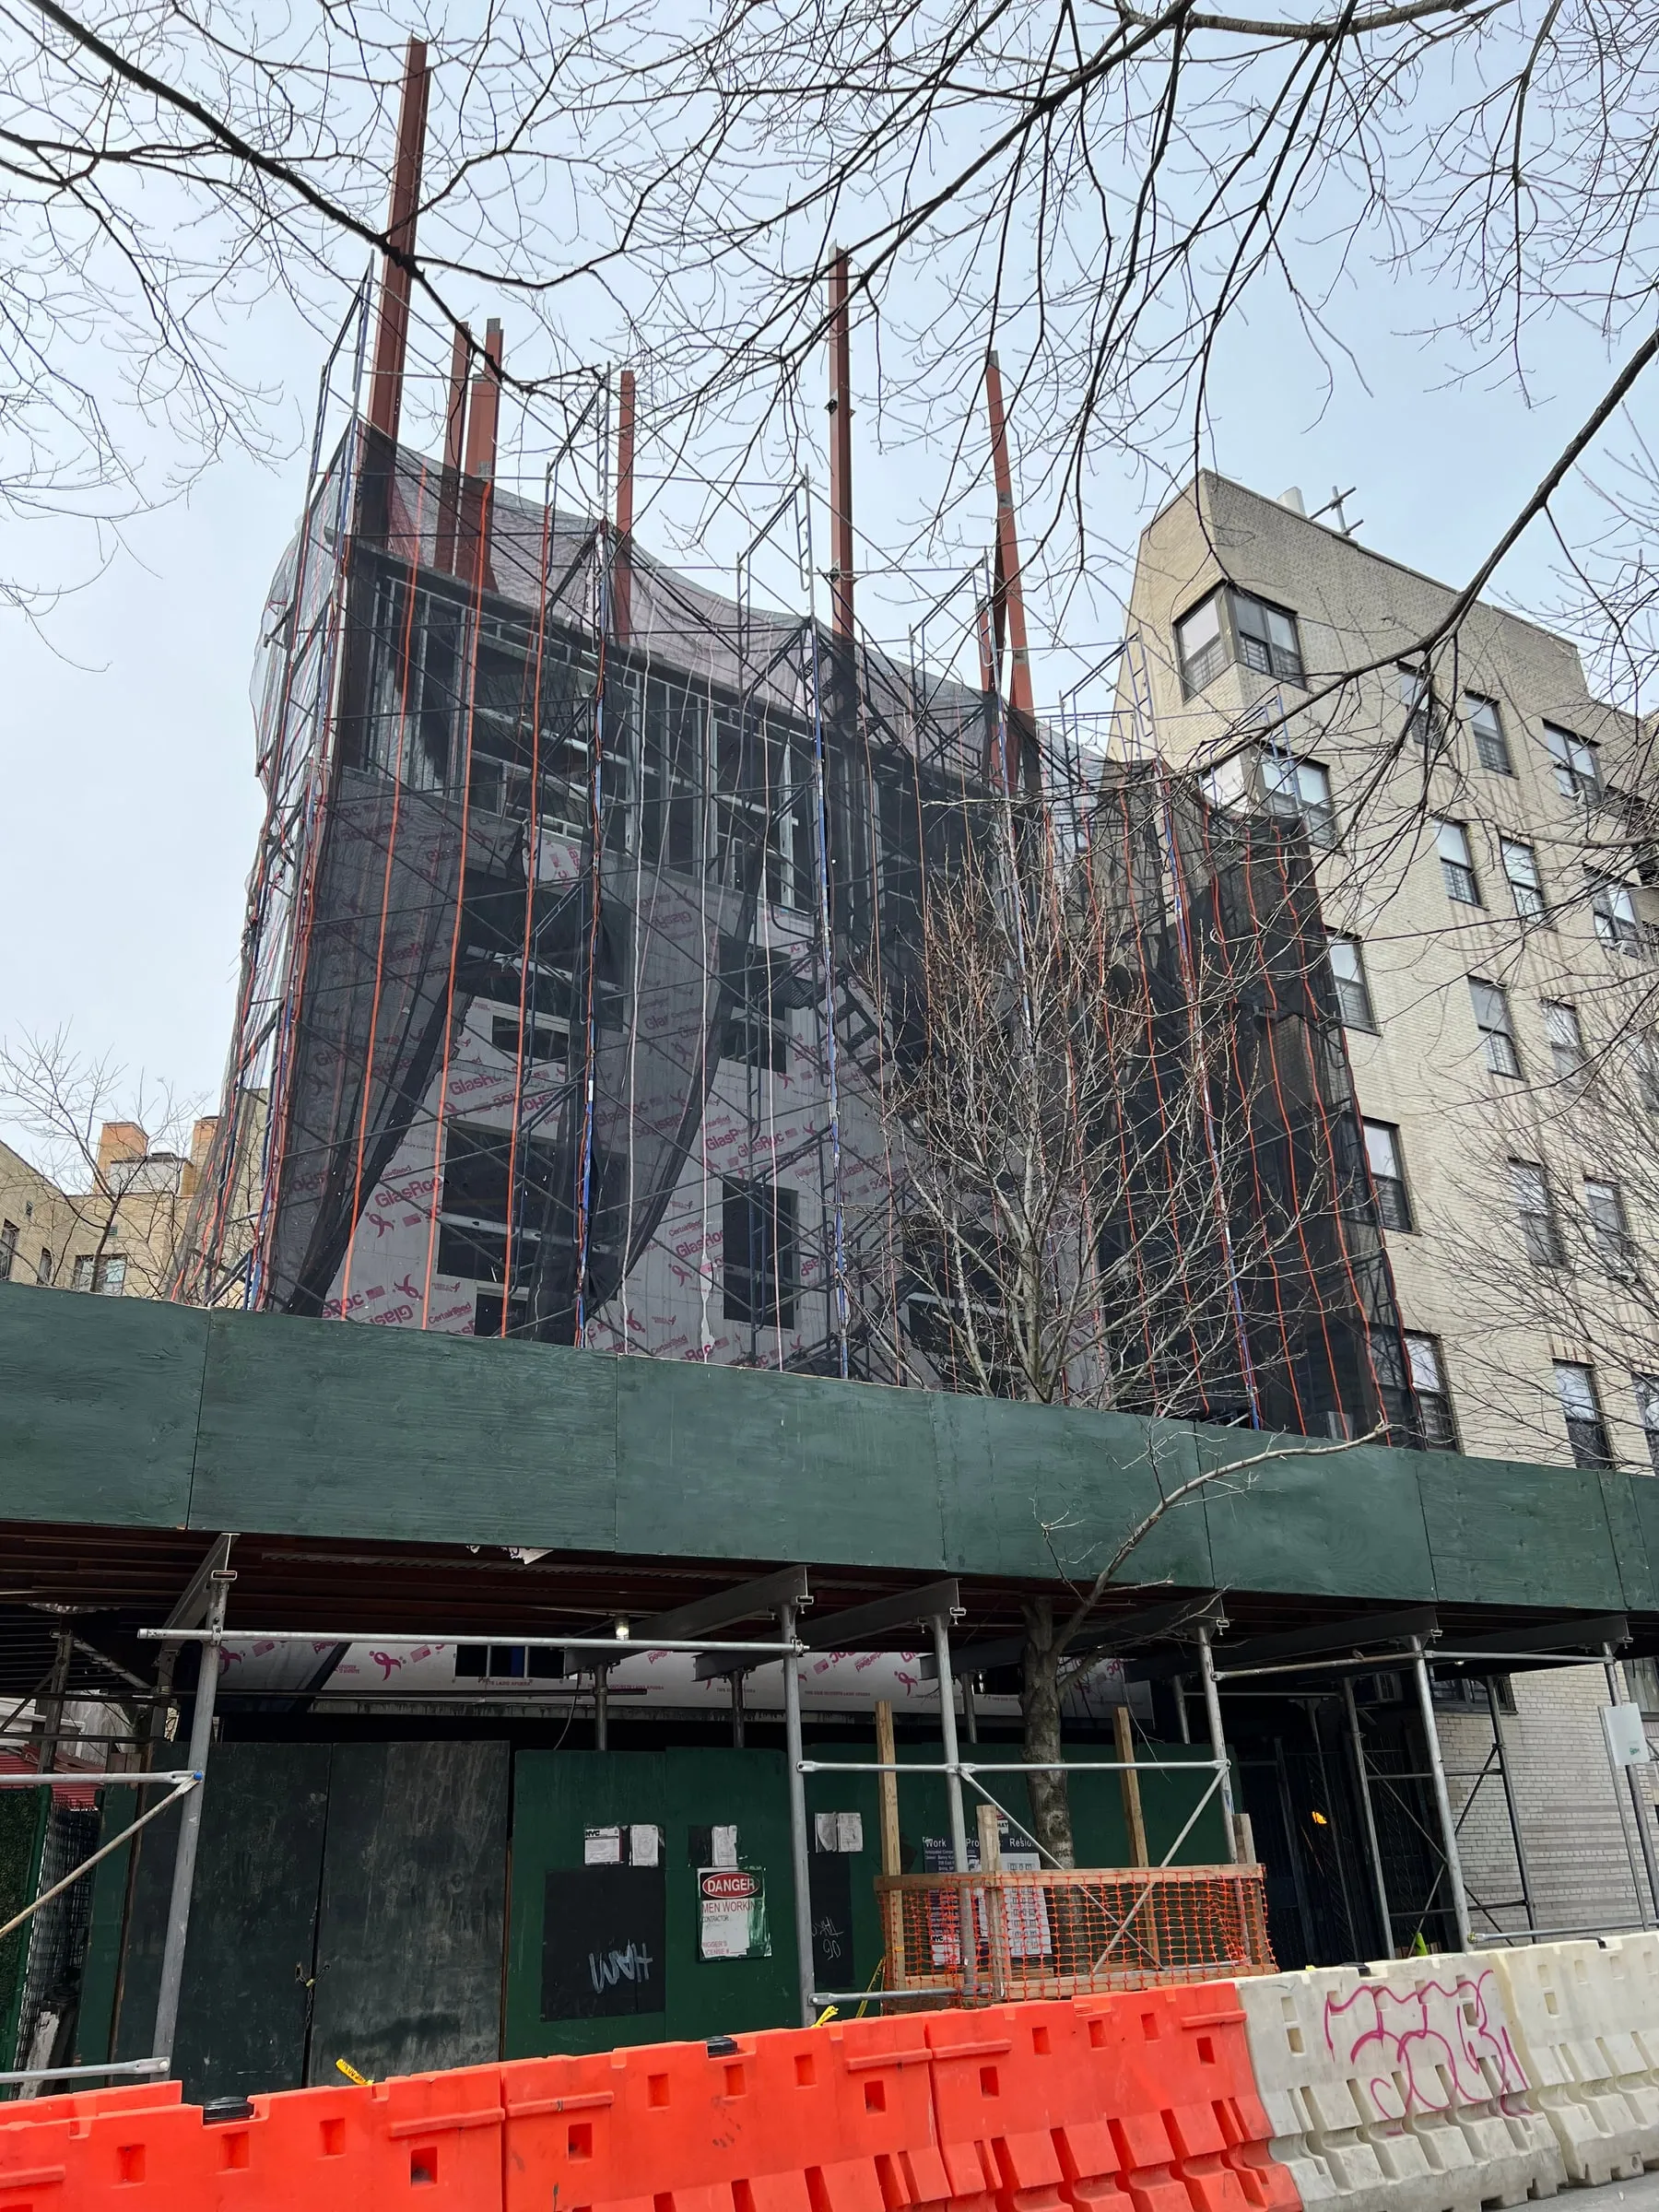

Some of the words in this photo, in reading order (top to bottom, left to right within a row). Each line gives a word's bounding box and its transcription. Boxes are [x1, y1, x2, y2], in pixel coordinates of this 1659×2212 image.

[707, 1877, 756, 1893] DANGER
[703, 1901, 721, 1913] MEN
[723, 1899, 763, 1912] WORKING
